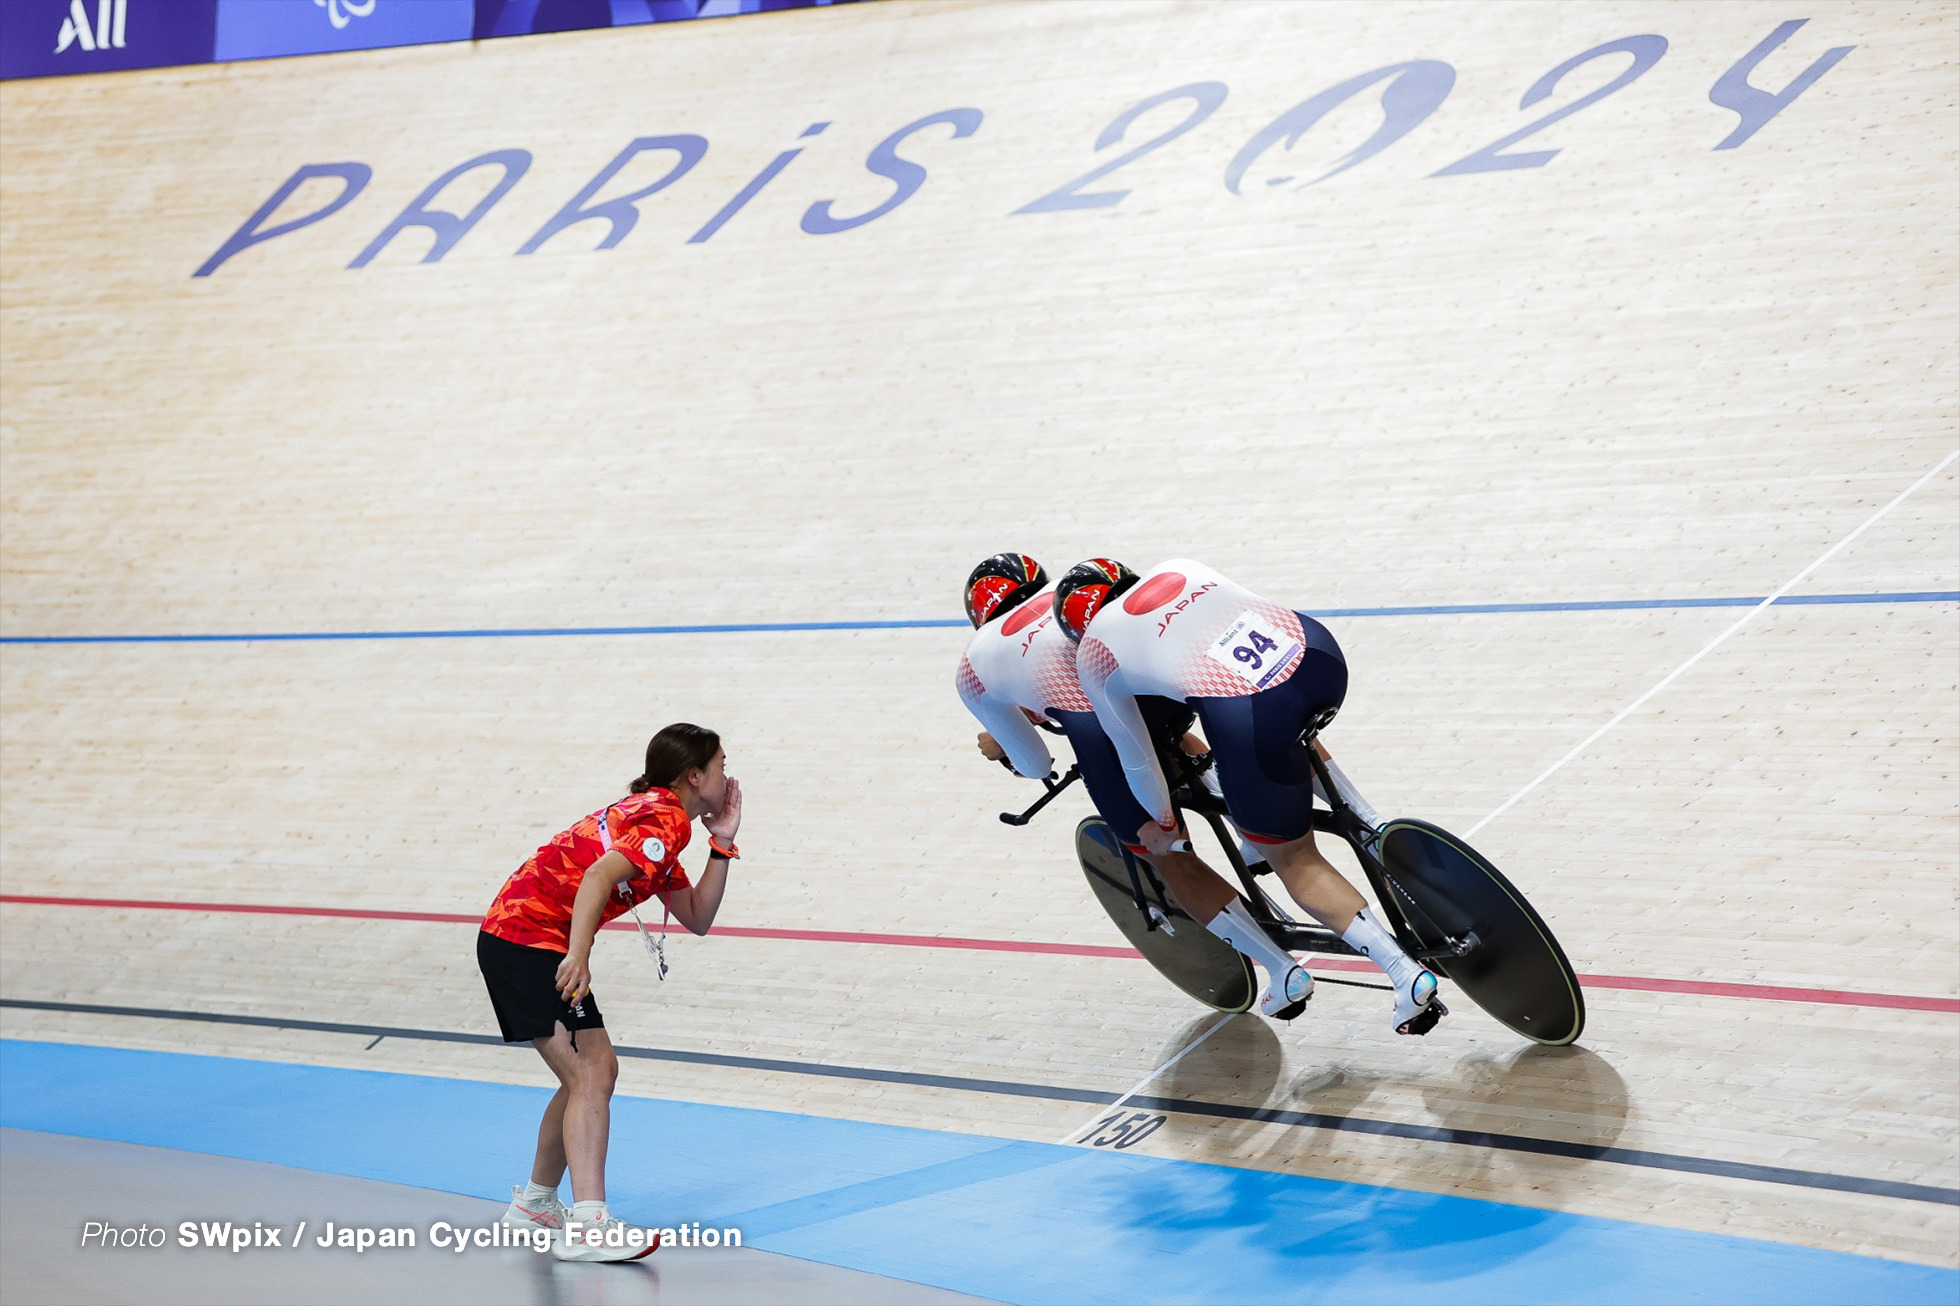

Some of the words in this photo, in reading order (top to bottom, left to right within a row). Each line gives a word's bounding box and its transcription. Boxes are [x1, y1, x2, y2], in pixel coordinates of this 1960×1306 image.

[1007, 17, 1858, 215] 2024
[1155, 581, 1218, 638] JAPAN
[1218, 628, 1239, 647] Allianz
[1233, 629, 1278, 670] 94
[1077, 1112, 1168, 1149] 150
